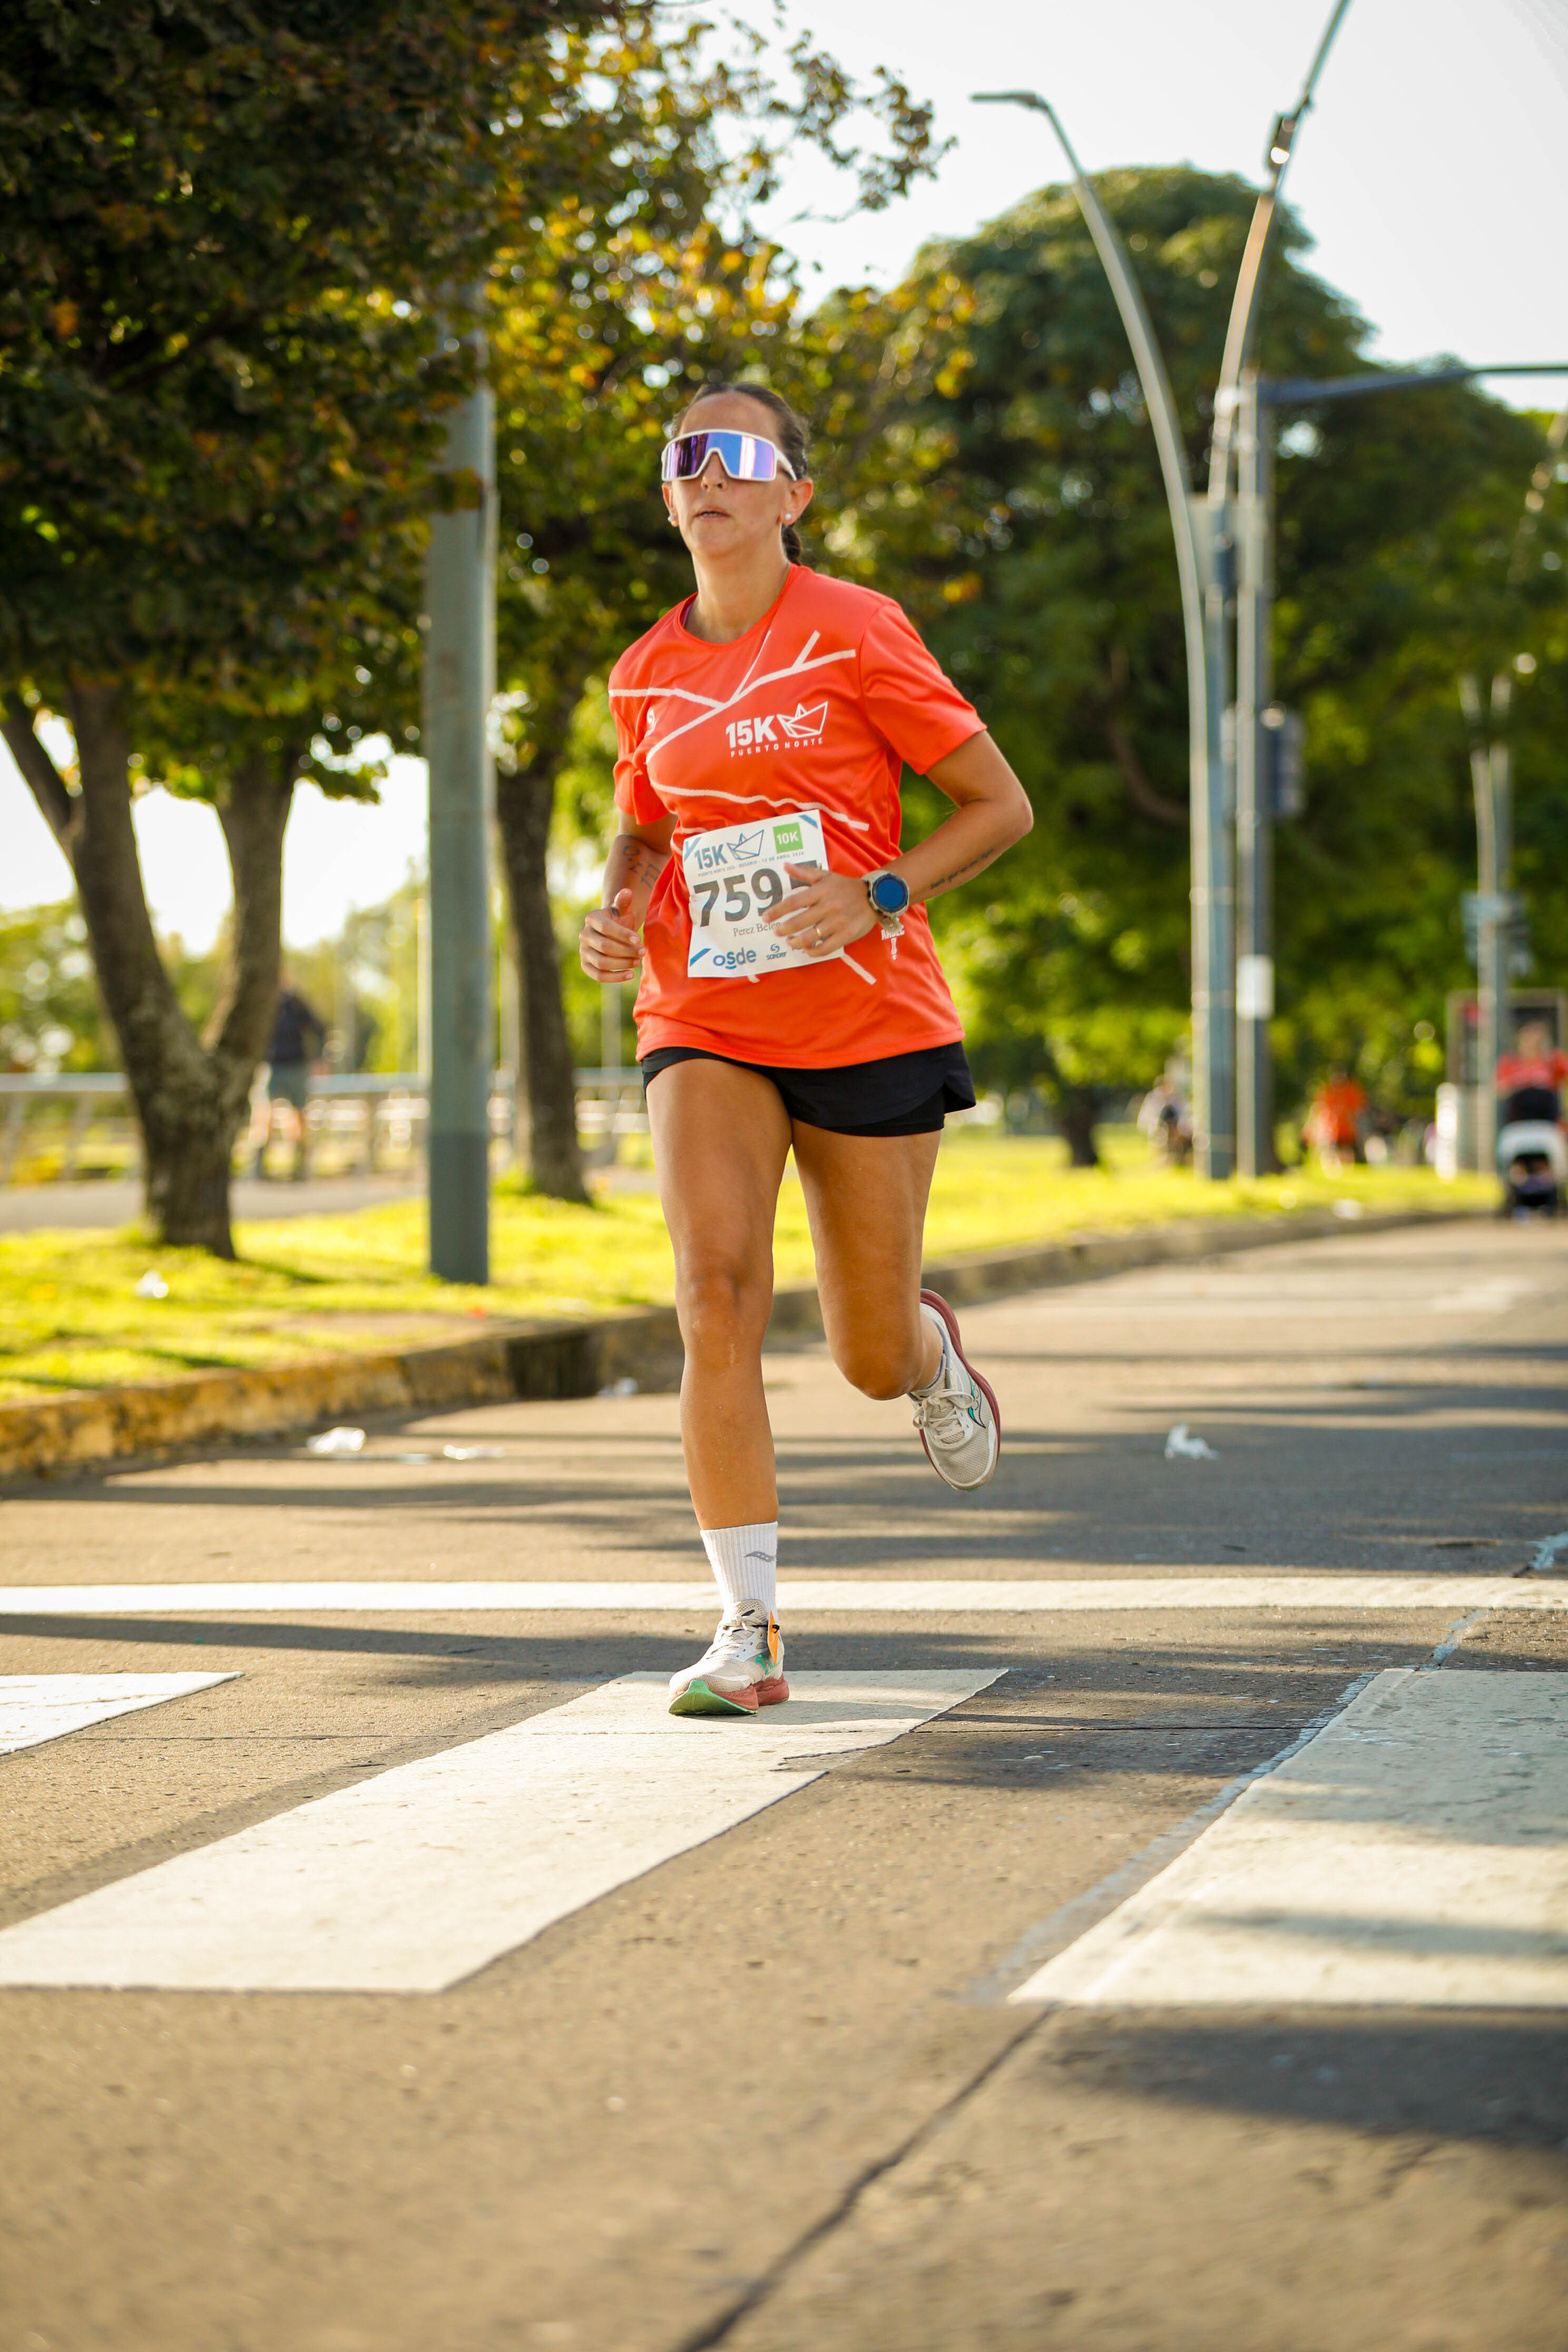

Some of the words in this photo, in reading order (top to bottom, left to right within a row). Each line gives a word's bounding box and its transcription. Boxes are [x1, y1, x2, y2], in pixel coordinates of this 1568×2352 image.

[726, 716, 777, 749] 15K
[730, 743, 779, 758] PUERTO
[785, 738, 822, 748] NORTE
[776, 830, 799, 845] 10K
[694, 844, 728, 869] 15K
[733, 927, 754, 937] Perez
[713, 947, 756, 966] osde
